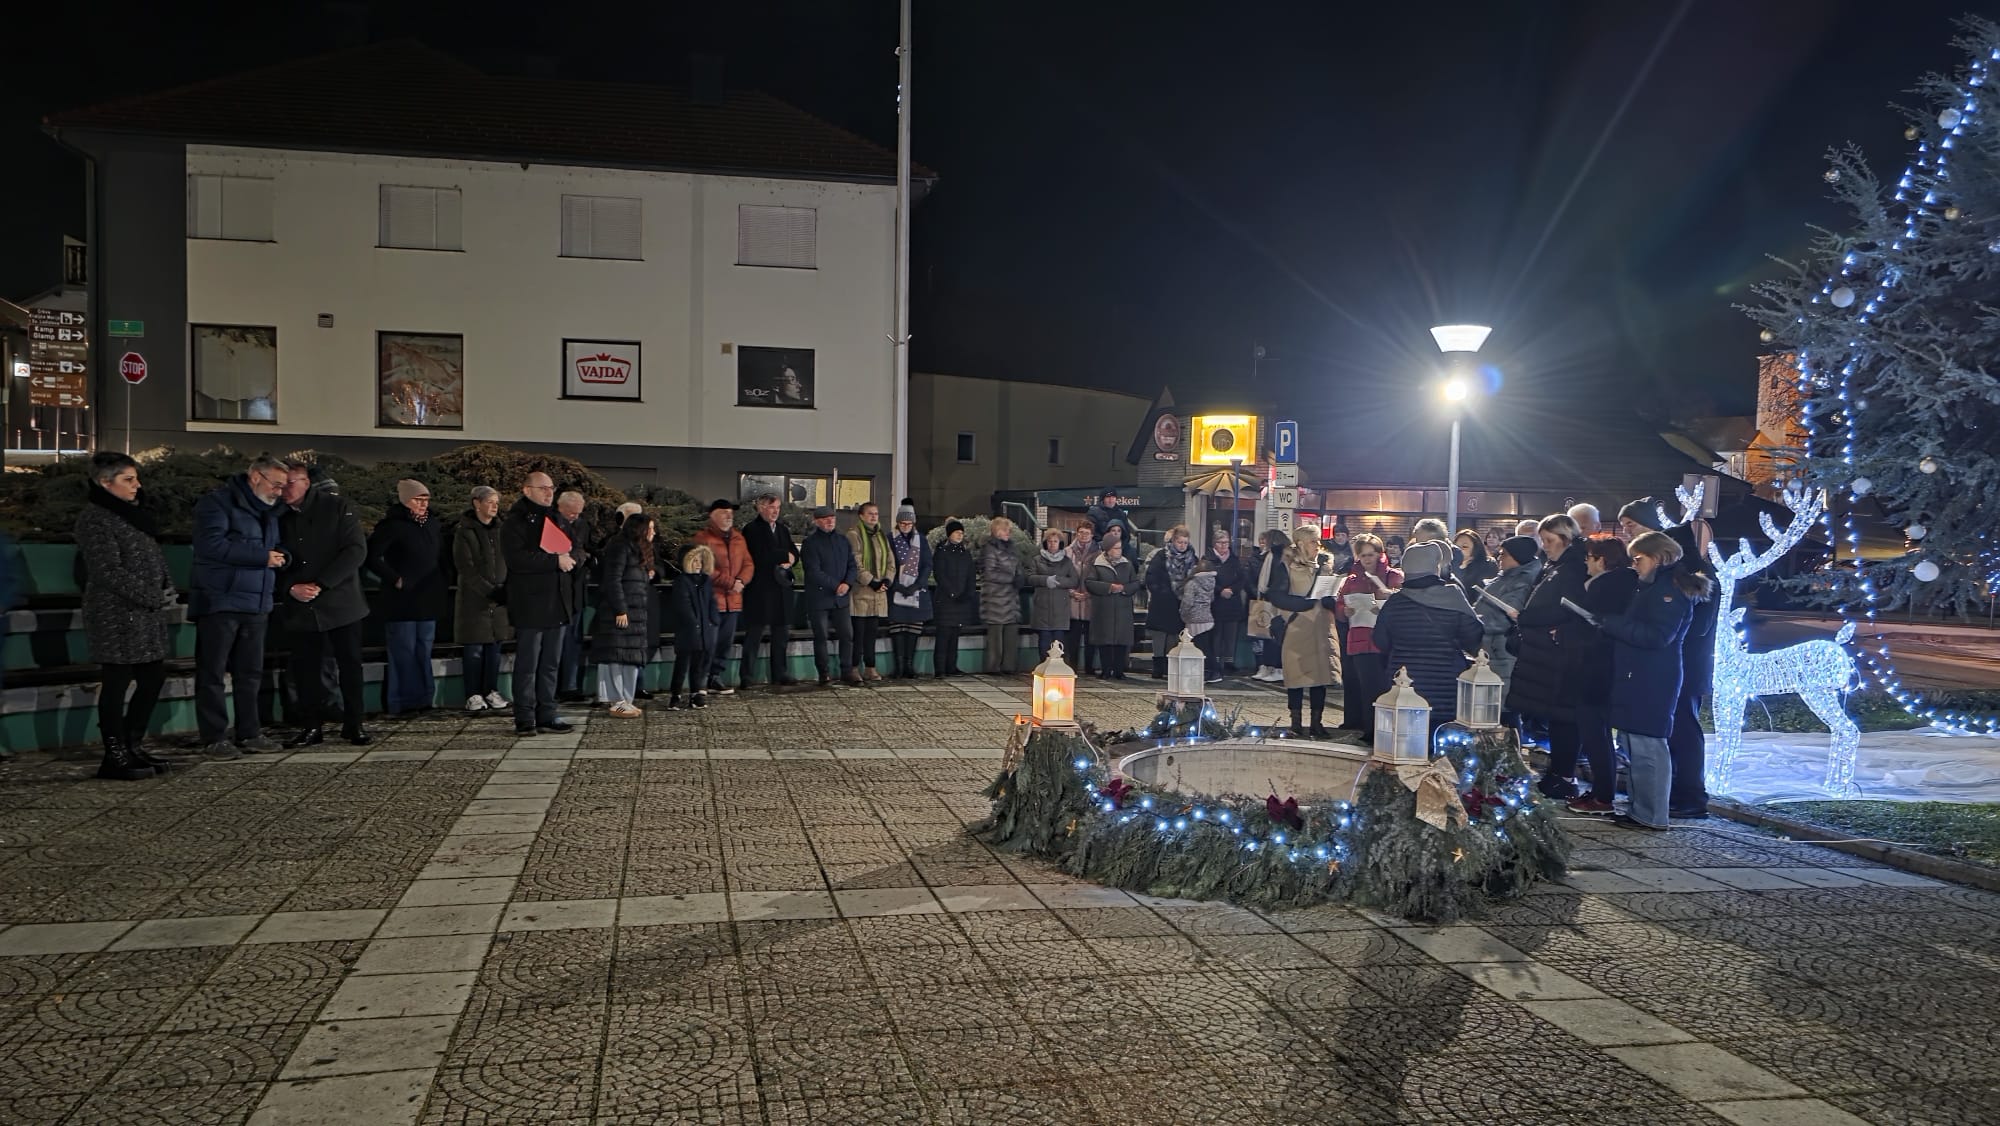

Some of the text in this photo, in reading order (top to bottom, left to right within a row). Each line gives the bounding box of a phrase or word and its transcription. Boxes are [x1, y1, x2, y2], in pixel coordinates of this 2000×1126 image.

[122, 361, 144, 375] STOP
[580, 366, 624, 378] VAJDA
[1280, 429, 1291, 457] P
[1279, 492, 1292, 504] WC
